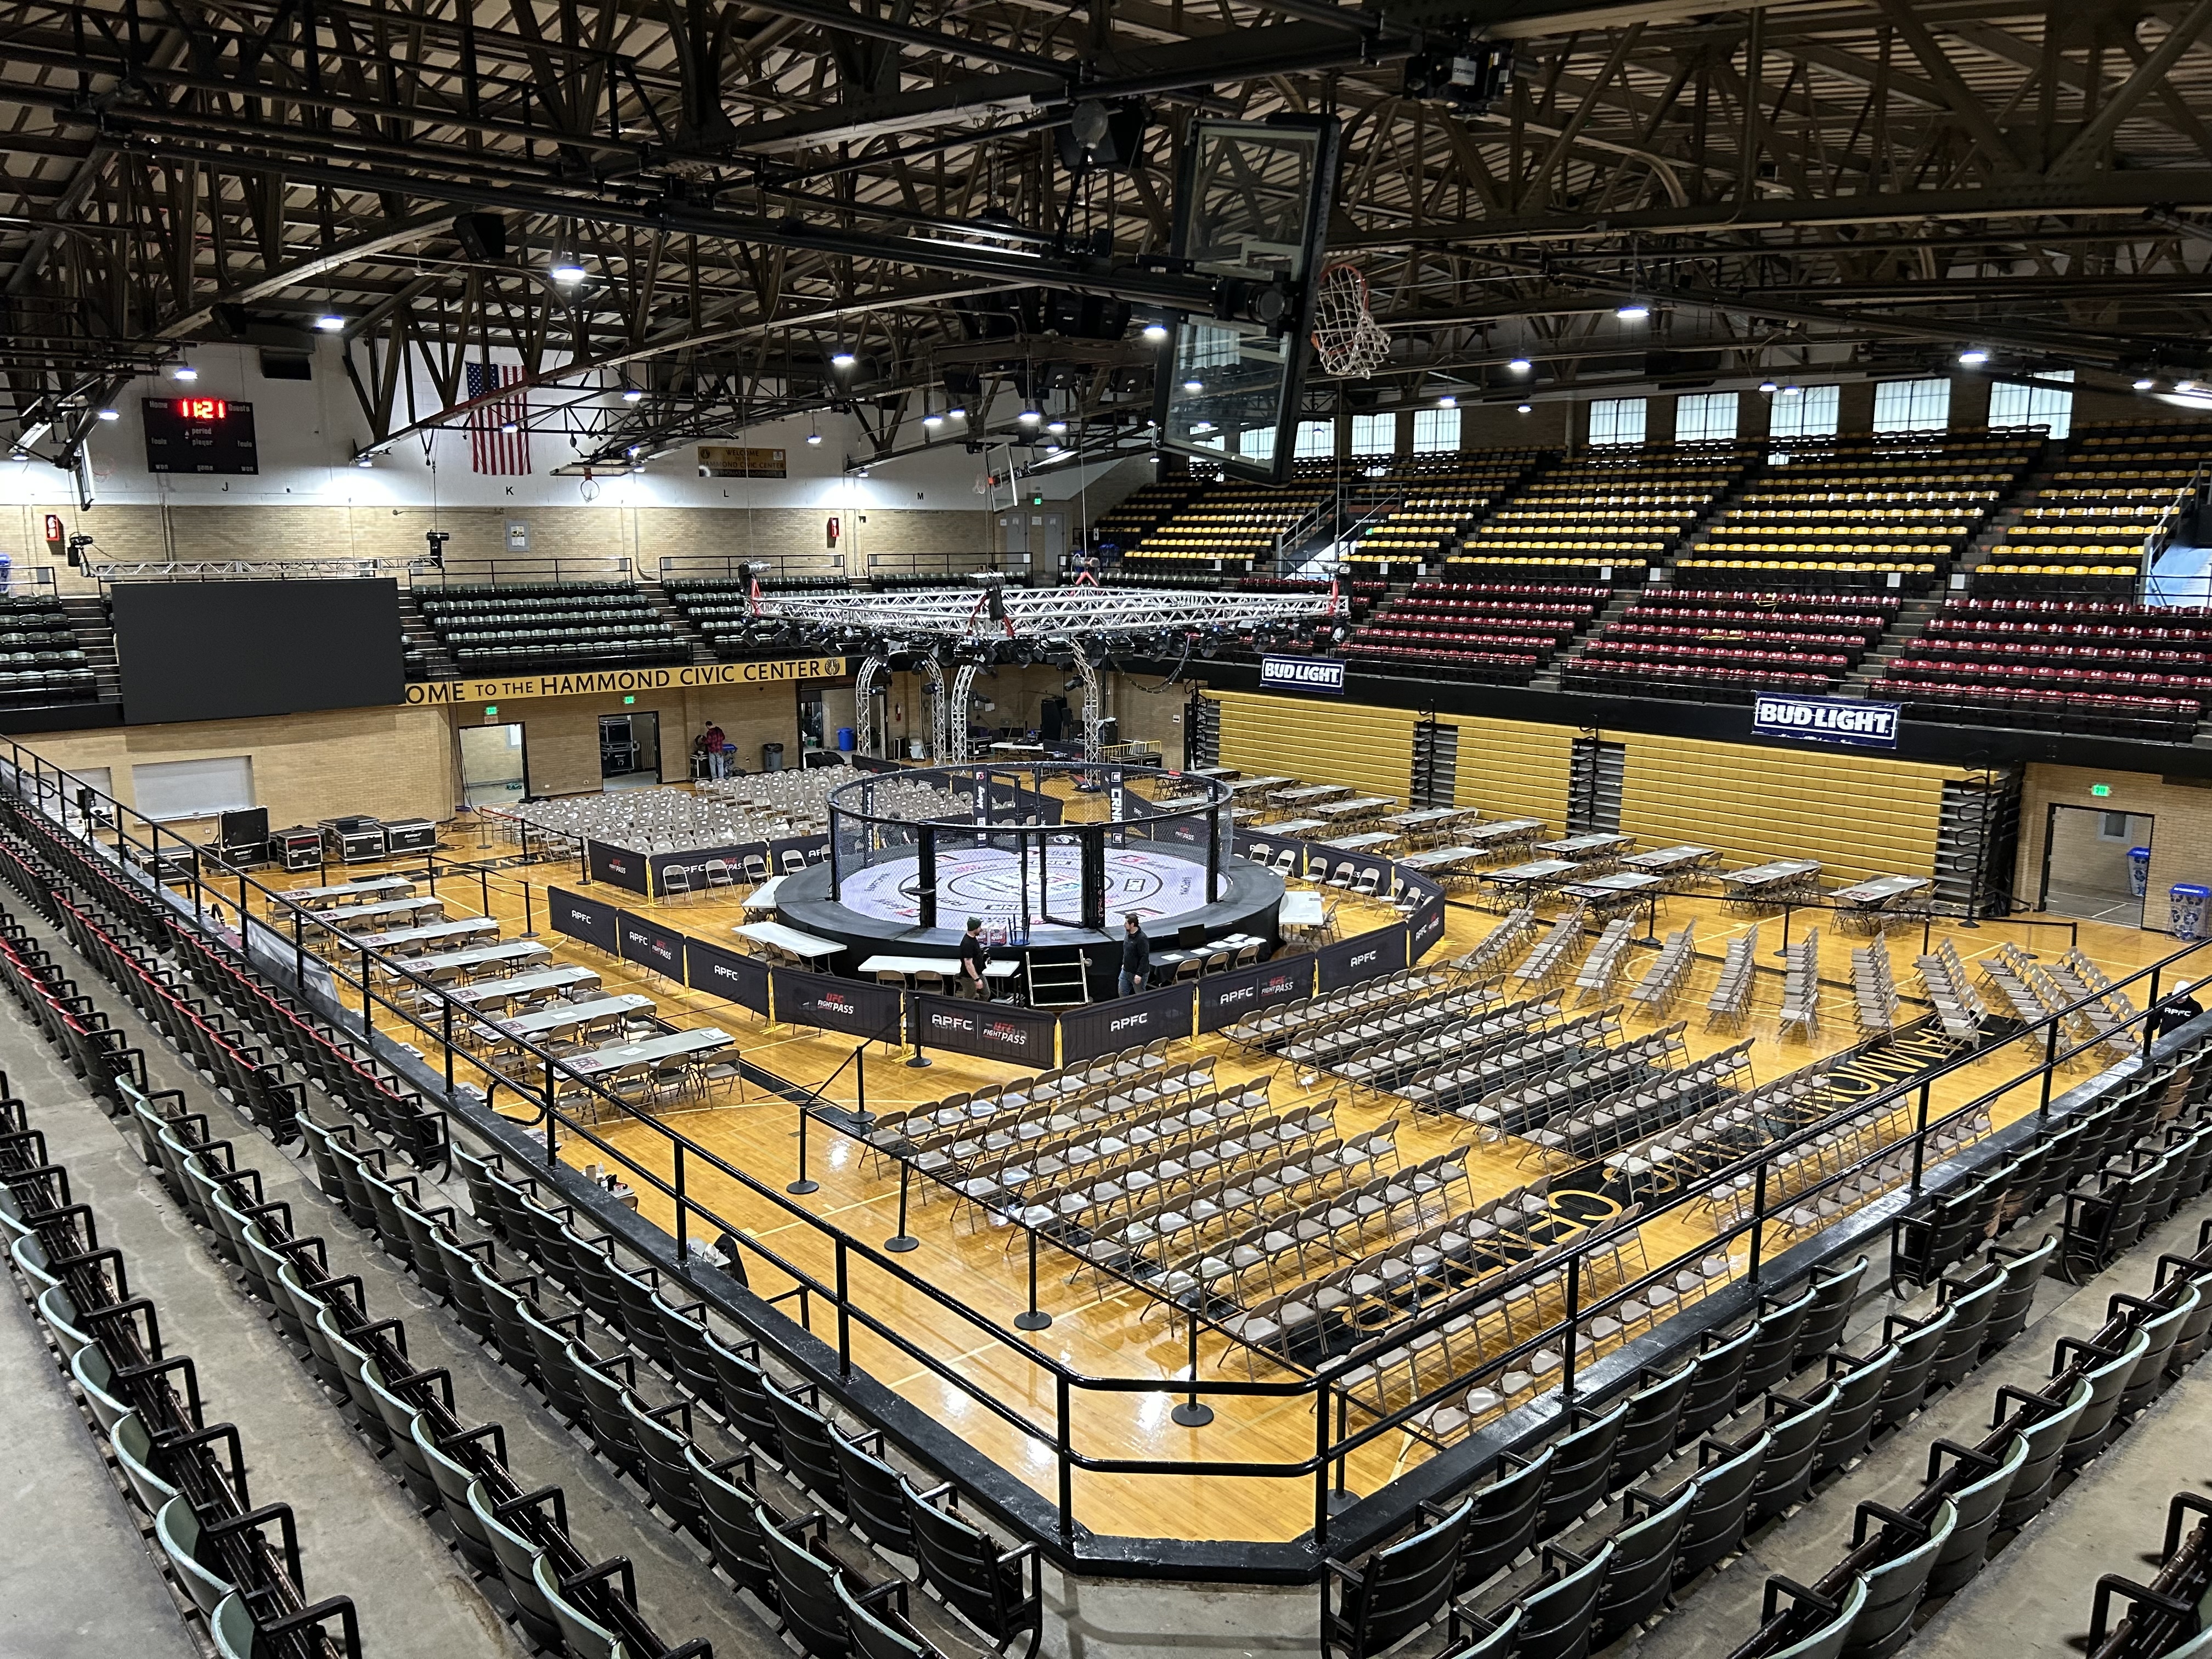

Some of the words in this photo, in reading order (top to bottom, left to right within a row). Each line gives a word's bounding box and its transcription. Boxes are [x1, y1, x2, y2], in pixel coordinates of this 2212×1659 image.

[150, 400, 168, 409] Home
[182, 399, 225, 419] 11:21
[222, 482, 228, 492] J
[506, 486, 514, 496] K
[724, 489, 729, 498] L
[475, 684, 496, 696] TO
[503, 681, 533, 695] THE
[541, 670, 670, 695] HAMMOND
[680, 665, 735, 685] CIVIC
[744, 660, 820, 681] CENTER
[1265, 663, 1295, 679] BUD
[1295, 665, 1340, 683] LIGHT
[1760, 703, 1812, 725] BUD
[1814, 708, 1892, 734] LIGHT
[616, 864, 626, 874] PASS
[572, 909, 591, 924] APFC
[629, 931, 648, 946] APFC
[660, 948, 672, 960] PASS
[1350, 950, 1376, 967] APFC
[714, 964, 738, 981] APFC
[1220, 986, 1254, 1005] APFC
[1261, 985, 1276, 995] FIGHT
[1274, 981, 1294, 994] PASS
[826, 992, 844, 1003] UFC
[817, 1000, 833, 1009] FIGHT
[832, 1003, 854, 1014] PASS
[2164, 1007, 2192, 1017] APFC
[932, 1014, 973, 1031] APFC
[993, 1022, 1015, 1031] UFC
[1110, 1013, 1148, 1032] APFC
[983, 1029, 1001, 1039] FIGHT
[1001, 1033, 1026, 1045] PASS
